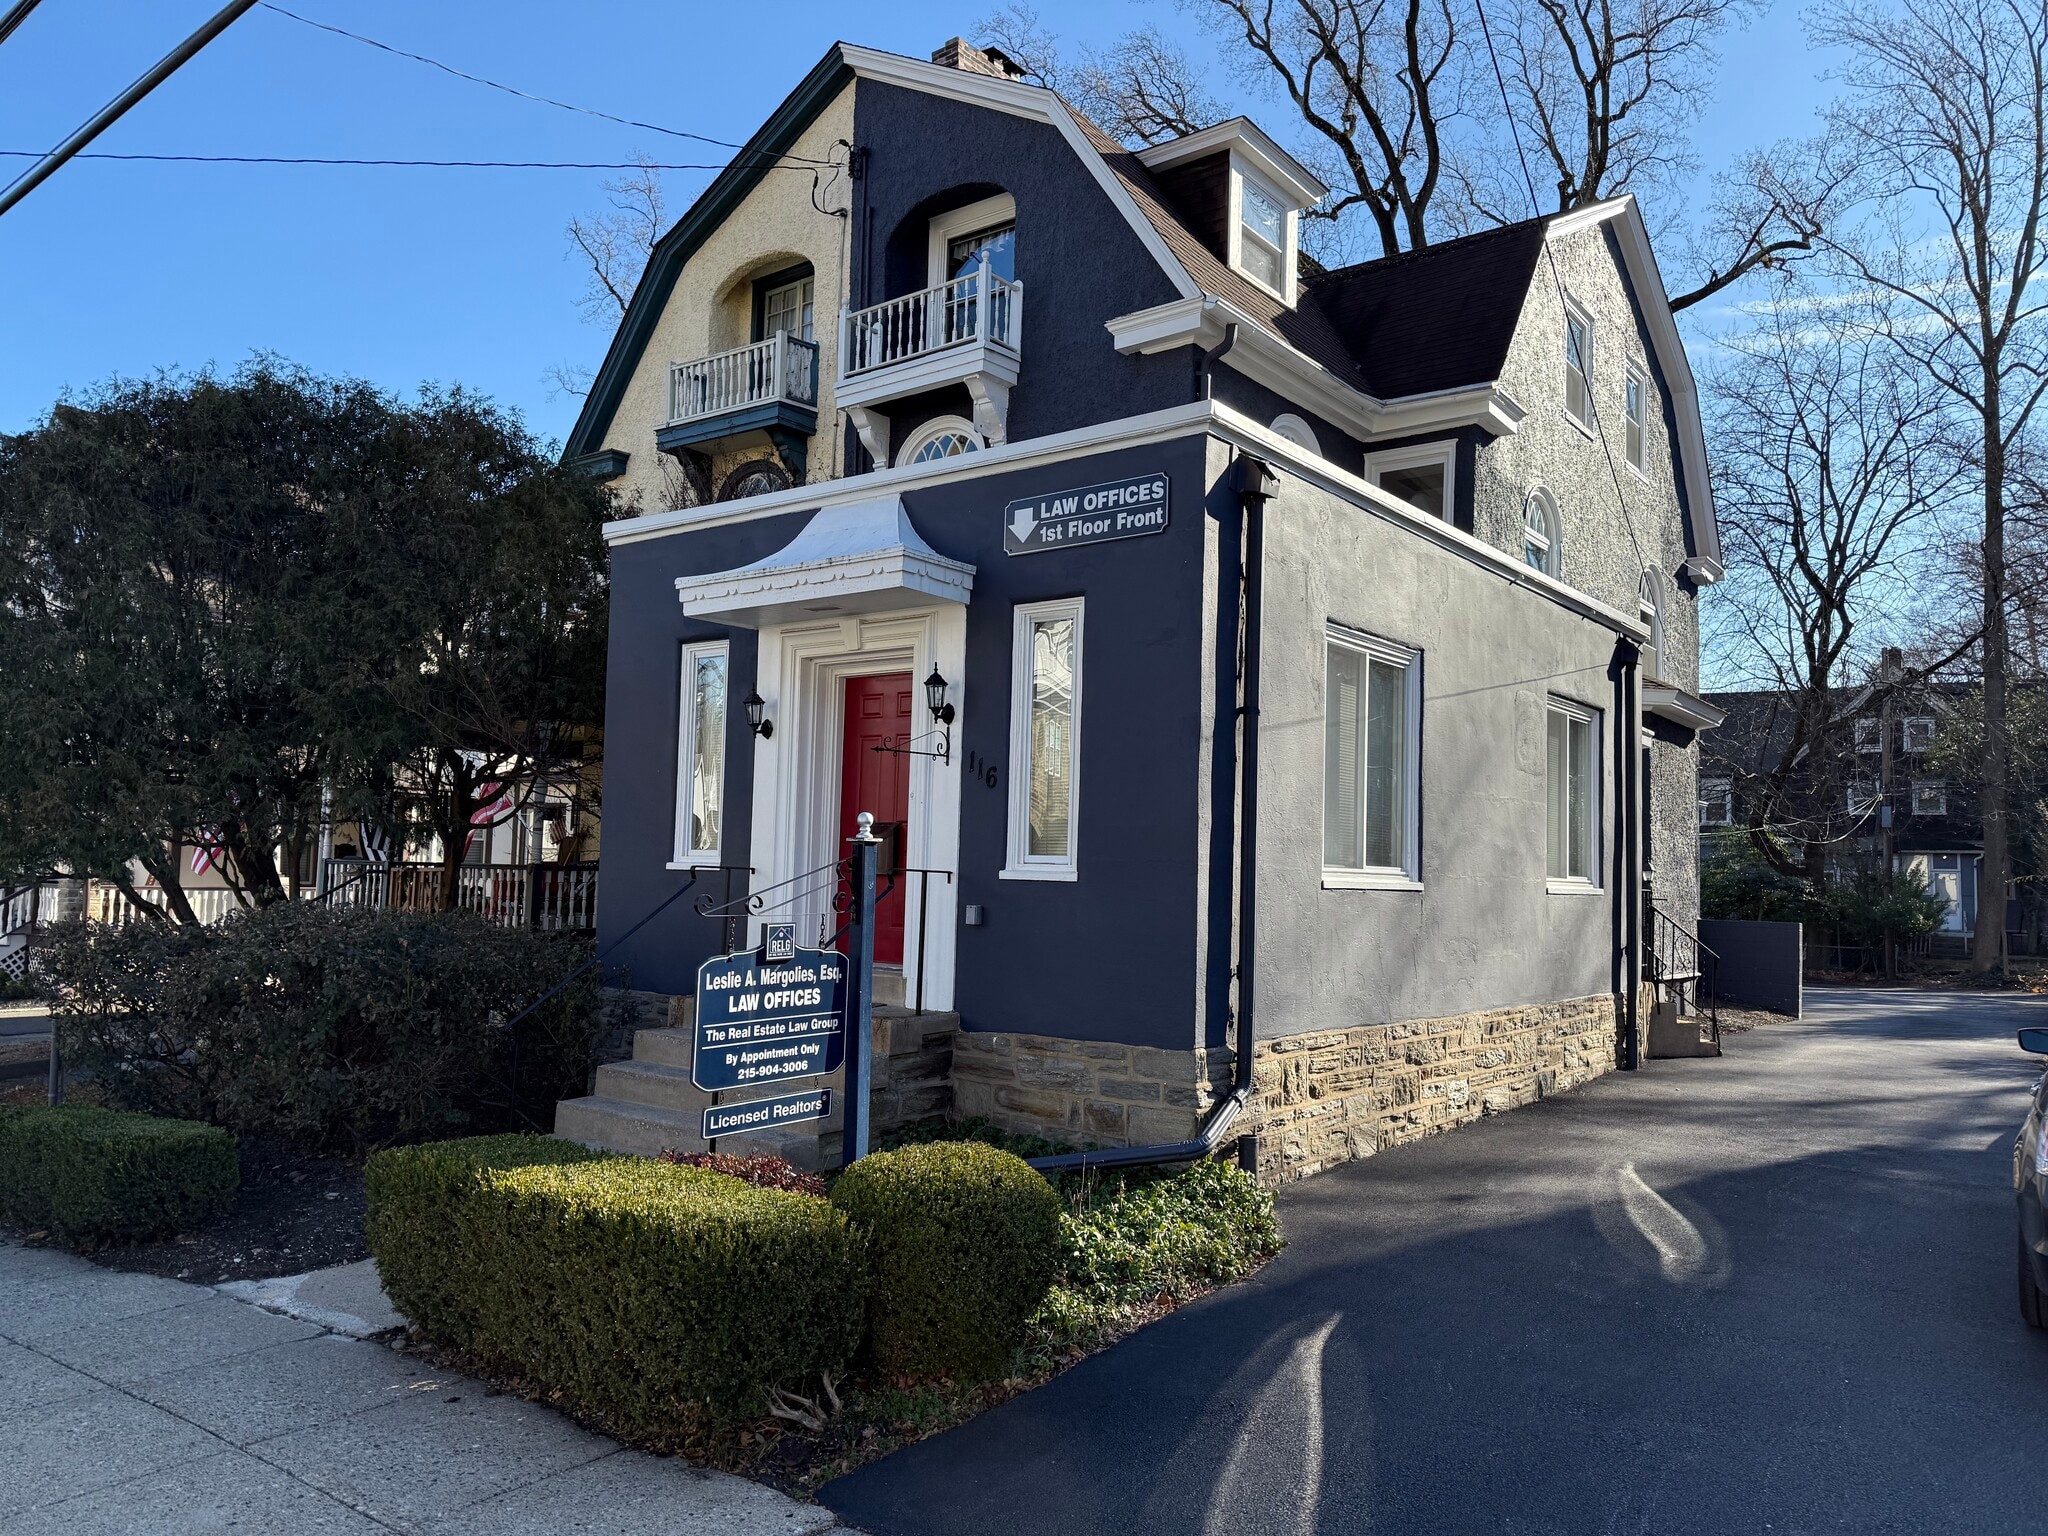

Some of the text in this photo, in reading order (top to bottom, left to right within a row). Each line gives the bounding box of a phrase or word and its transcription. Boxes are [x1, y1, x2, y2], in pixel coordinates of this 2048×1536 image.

[1040, 481, 1164, 519] LAW OFFICES
[1040, 507, 1164, 542] 1st Floor Front
[969, 750, 998, 789] 116
[771, 939, 791, 952] RELG
[705, 964, 842, 990] Leslie A. Margolies, Esq.
[728, 987, 821, 1013] LAW OFFICES
[705, 1018, 839, 1042] The Real Estate Law Group
[725, 1043, 820, 1066] By Appointment Only
[737, 1060, 809, 1080] 215-904-3006
[710, 1099, 823, 1130] Licensed Realtors
